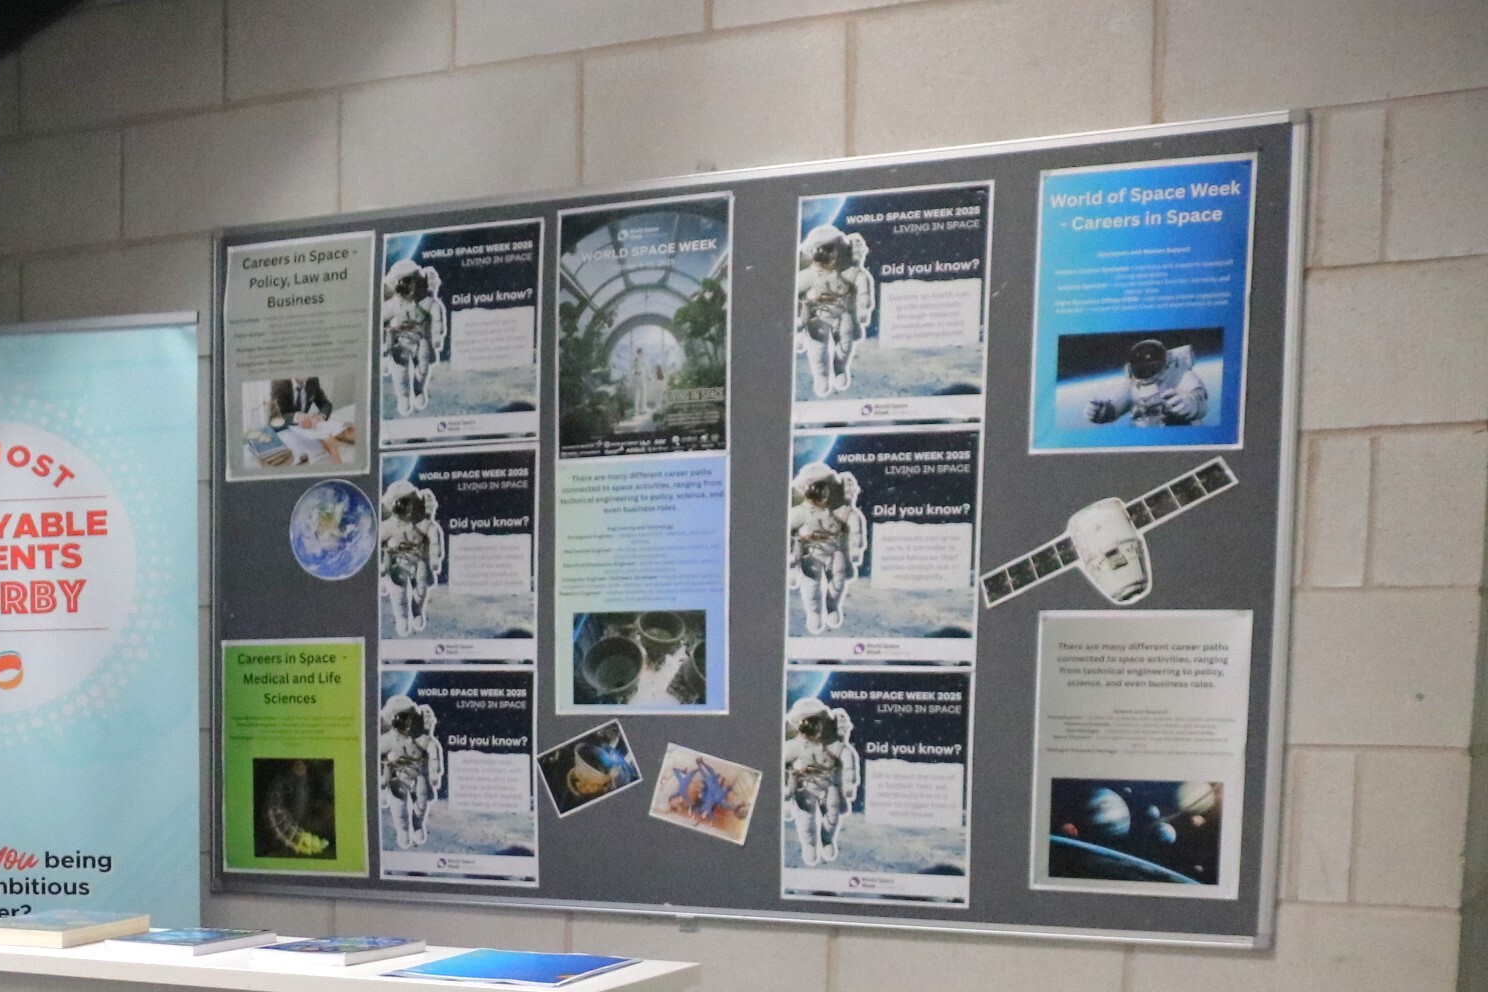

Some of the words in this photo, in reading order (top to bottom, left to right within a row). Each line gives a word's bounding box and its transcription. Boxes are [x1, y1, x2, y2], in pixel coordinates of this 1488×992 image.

[1050, 190, 1103, 208] World
[1108, 188, 1127, 204] of
[1131, 187, 1185, 204] Space
[1191, 180, 1241, 198] Week
[846, 214, 884, 224] WORLD
[886, 210, 920, 221] SPACE
[924, 208, 953, 217] WEEK
[956, 206, 980, 215] 2025
[1072, 214, 1140, 230] Careers
[1145, 211, 1161, 225] in
[1167, 209, 1223, 226] Space
[423, 249, 453, 258] WORLD
[456, 245, 484, 256] SPACE
[486, 243, 510, 252] WEEK
[243, 255, 290, 269] Careers
[294, 252, 305, 263] in
[310, 249, 349, 264] Space
[882, 263, 904, 275] Did
[908, 264, 932, 275] you
[936, 259, 980, 272] know?
[250, 276, 290, 289] Policy,
[294, 273, 319, 284] Law
[323, 268, 347, 282] and
[268, 294, 324, 308] Business
[452, 293, 471, 304] Did
[474, 293, 493, 304] you
[496, 288, 533, 300] know?
[838, 454, 875, 463] WORLD
[878, 452, 912, 461] SPACE
[914, 452, 944, 460] WEEK
[946, 451, 970, 459] 2025
[419, 472, 450, 480] WORLD
[452, 470, 480, 478] SPACE
[482, 469, 505, 477] WEEK
[874, 504, 896, 515] Did
[900, 505, 923, 517] you
[927, 503, 970, 514] know?
[450, 518, 468, 528] Did
[471, 519, 490, 529] you
[493, 516, 529, 527] know?
[238, 653, 282, 664] Careers
[285, 653, 296, 663] in
[299, 652, 336, 665] Space
[243, 673, 289, 684] Medical
[293, 673, 314, 684] and
[319, 672, 341, 683] Life
[264, 693, 316, 704] Sciences
[417, 689, 448, 697] WORLD
[450, 689, 478, 697] SPACE
[480, 689, 504, 697] WEEK
[831, 691, 867, 700] WORLD
[870, 691, 904, 700] SPACE
[906, 691, 935, 700] WEEK
[938, 692, 962, 700] 2025
[448, 735, 467, 745] Did
[469, 737, 489, 748] you
[492, 735, 528, 746] know?
[866, 742, 887, 753] Did
[892, 744, 915, 756] you
[919, 743, 962, 755] know?
[45, 851, 111, 872] being
